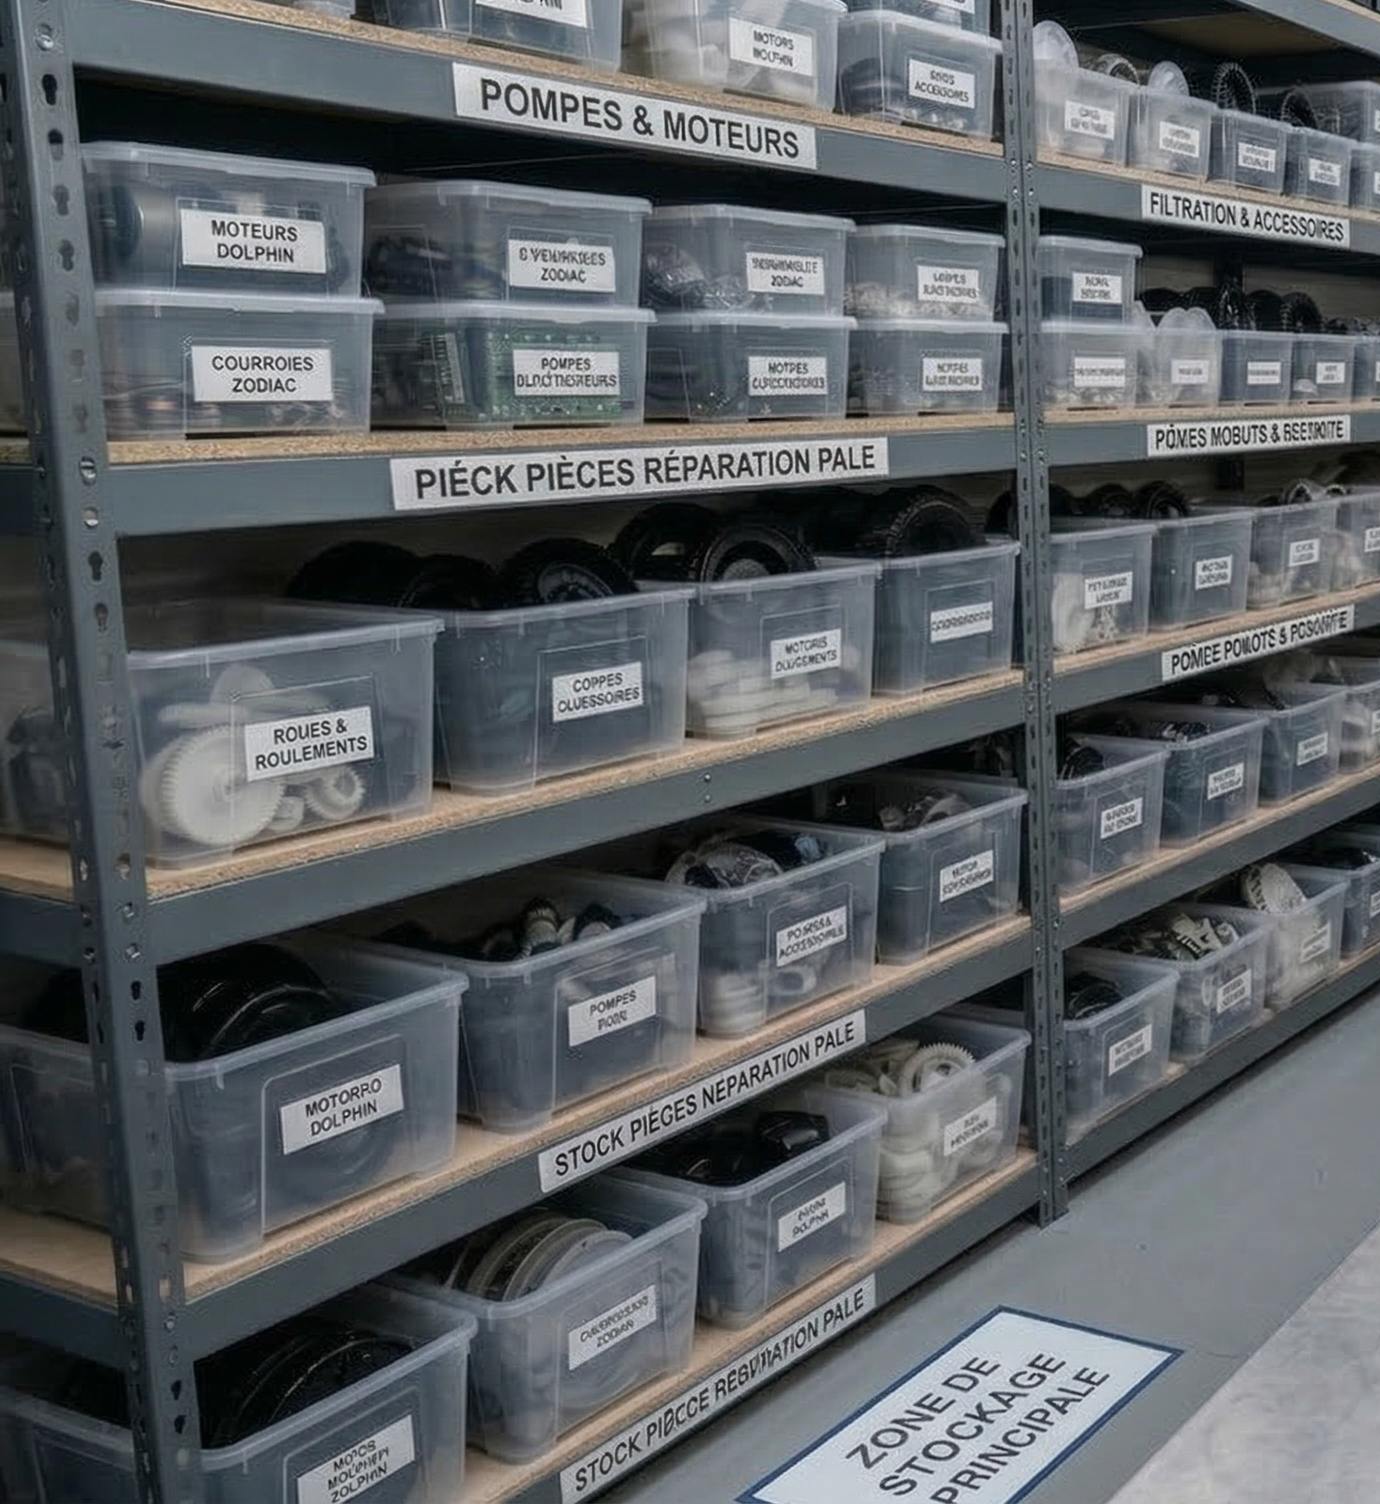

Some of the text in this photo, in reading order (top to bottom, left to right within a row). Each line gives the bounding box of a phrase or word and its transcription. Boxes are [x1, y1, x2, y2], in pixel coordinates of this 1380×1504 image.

[481, 77, 799, 158] POMPES & MOTEURS
[211, 220, 298, 242] MOTEURS
[1150, 192, 1344, 242] FILTRATION & ACCESSOIRES
[217, 243, 294, 263] DOLPHIN
[541, 268, 587, 283] ZODIAC
[212, 355, 313, 371] COURROIES
[541, 357, 591, 371] POMPES
[232, 378, 296, 392] ZODIAC
[415, 445, 876, 499] PIÉCK PIÈCES RÉPARATION PALE
[573, 672, 623, 693] COPPES
[274, 718, 347, 745] ROUES &
[255, 735, 368, 770] ROULEMENTS
[589, 989, 637, 1017] POMPES
[555, 1125, 624, 1176] STOCK
[702, 1041, 810, 1108] NEPARATION
[815, 1021, 855, 1057] PALE
[310, 1099, 377, 1136] DOLPHIN
[575, 1431, 641, 1491] STOCK
[823, 1288, 864, 1332] PALE
[845, 1357, 1001, 1469] ZONE DE
[879, 1354, 1066, 1496] STOCKAGE
[930, 1367, 1110, 1504] PRINCIPALE
